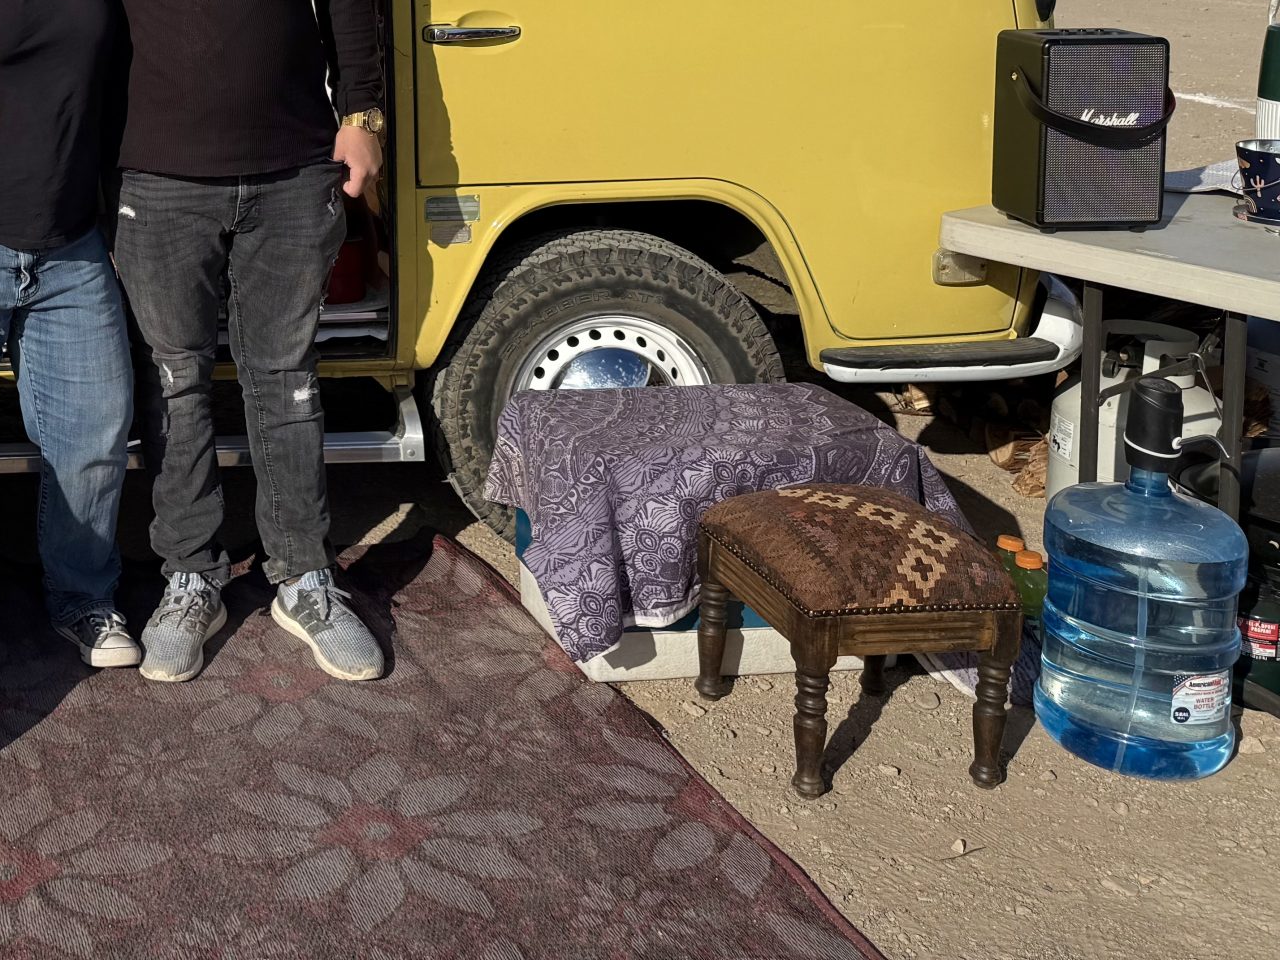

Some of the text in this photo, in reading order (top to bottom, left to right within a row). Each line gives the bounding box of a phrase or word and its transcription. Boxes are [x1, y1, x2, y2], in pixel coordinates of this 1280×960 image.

[1080, 109, 1140, 126] Marshall
[229, 625, 375, 648] ARB TOURING
